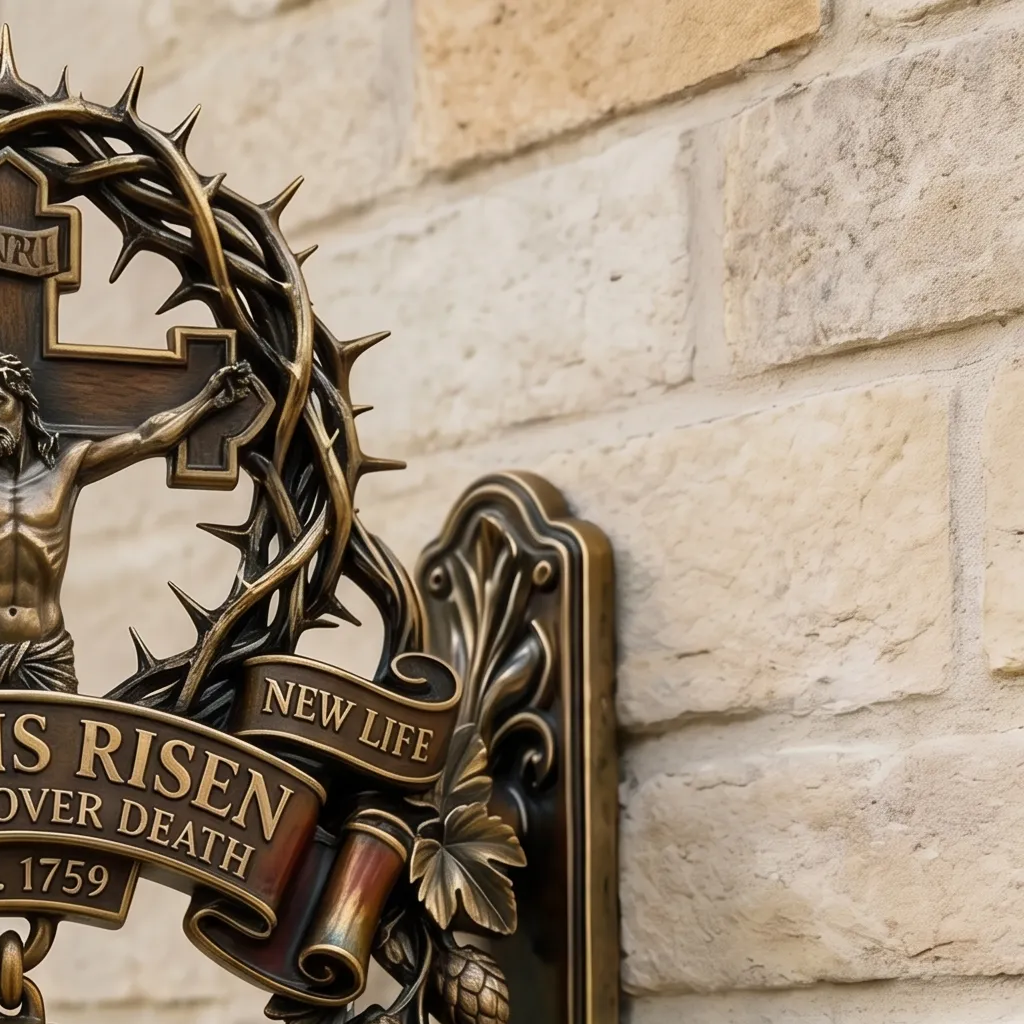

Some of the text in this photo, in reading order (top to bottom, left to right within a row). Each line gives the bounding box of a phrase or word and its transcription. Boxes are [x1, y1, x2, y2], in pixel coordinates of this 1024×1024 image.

[262, 677, 434, 762] NEW LIFE
[76, 719, 295, 842] RISEN
[20, 857, 109, 897] 1759
[117, 798, 255, 880] DEATH
